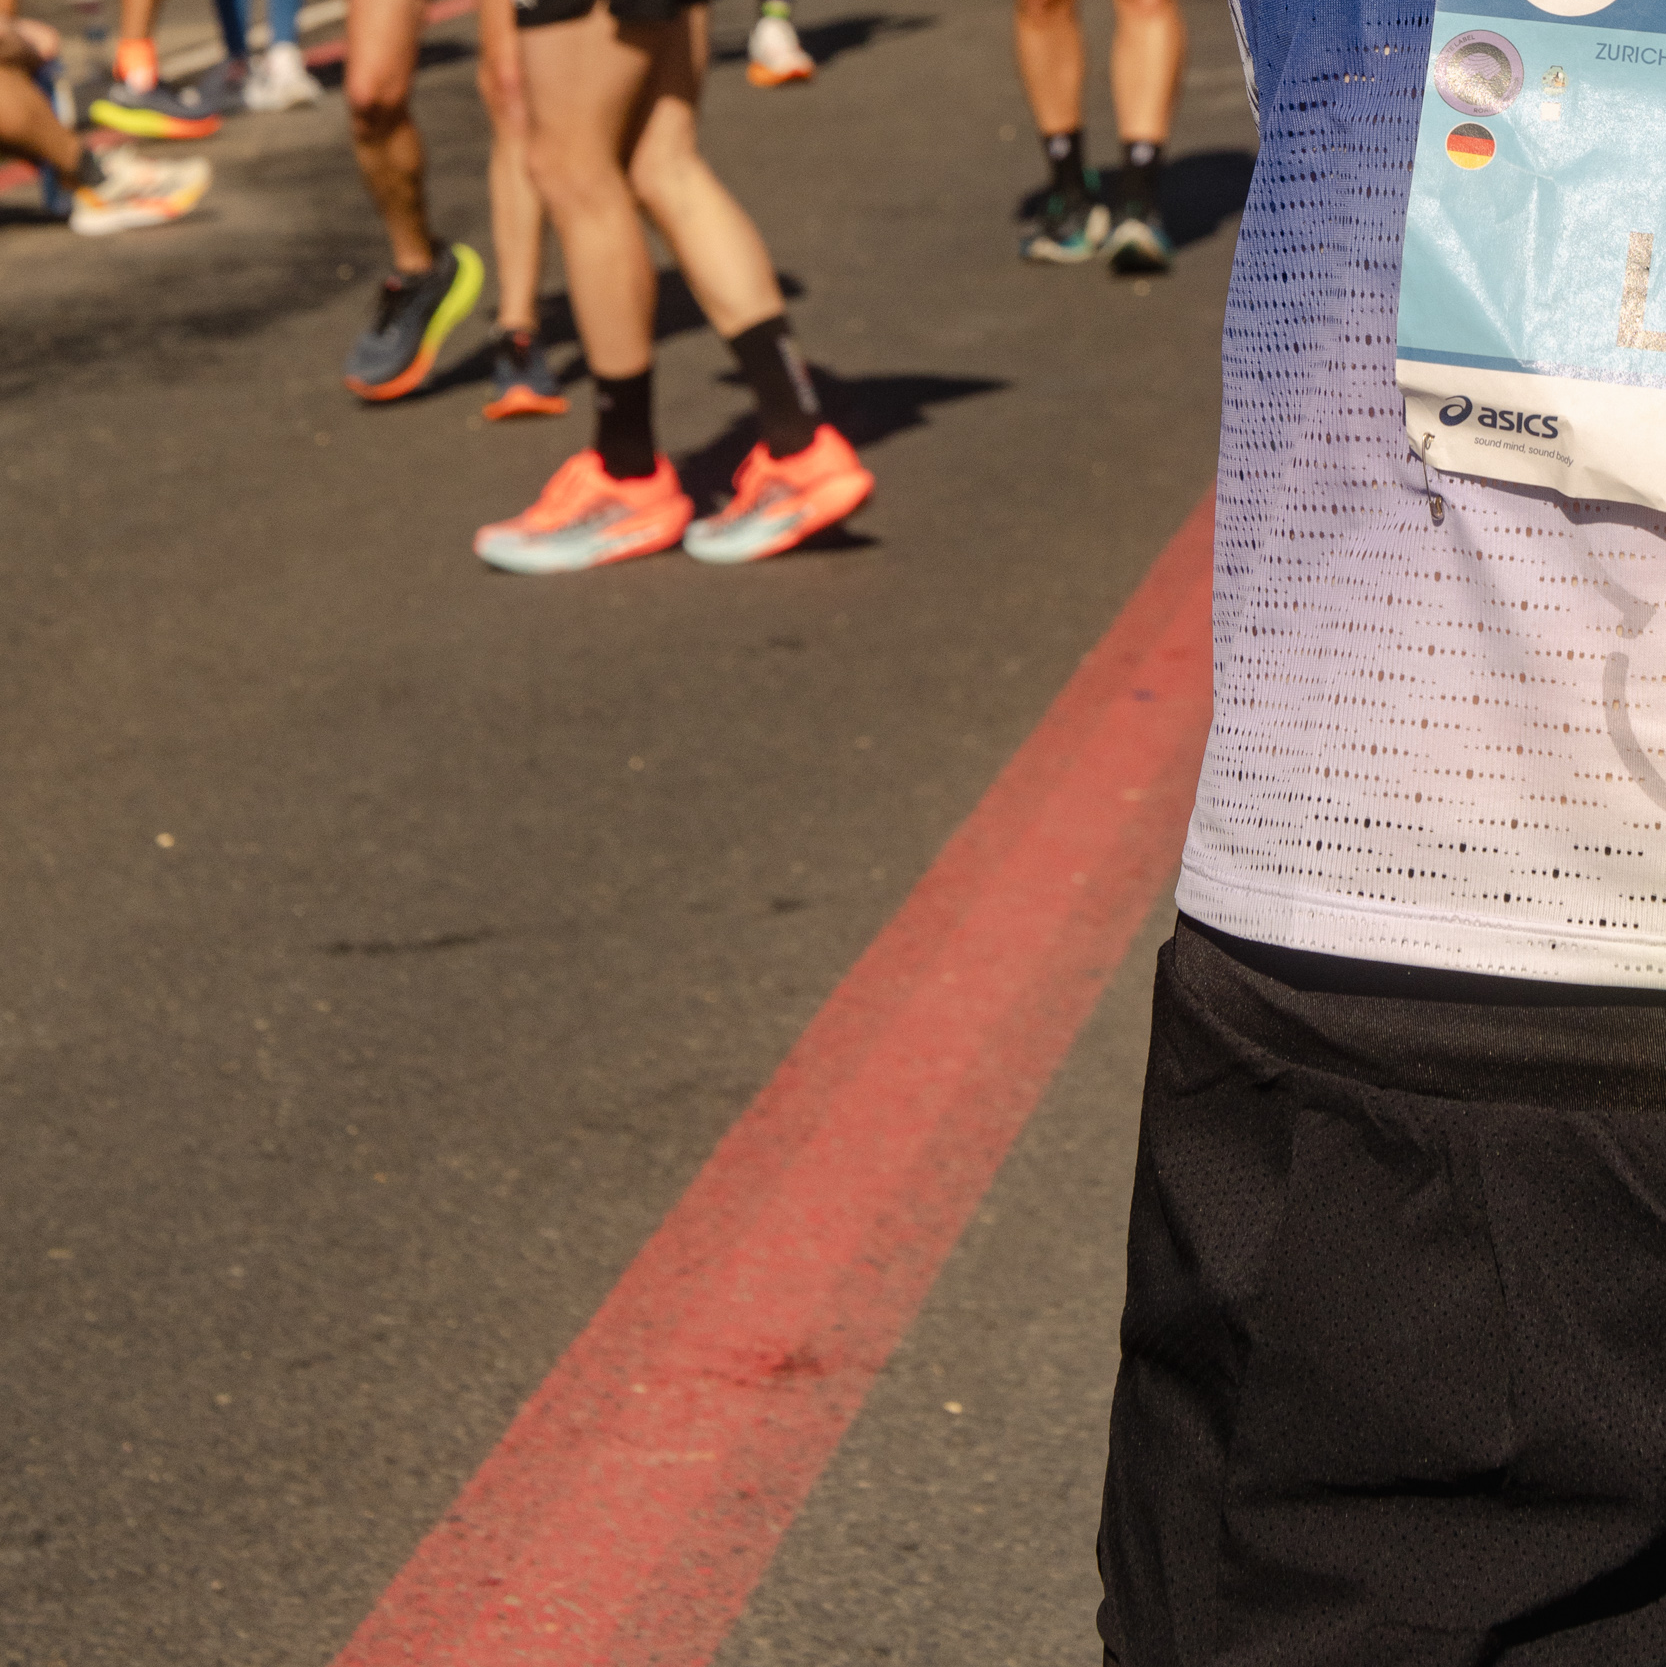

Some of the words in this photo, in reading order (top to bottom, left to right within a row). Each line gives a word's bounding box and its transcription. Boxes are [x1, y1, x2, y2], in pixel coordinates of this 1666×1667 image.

[1453, 34, 1476, 48] LABEL
[1473, 107, 1494, 115] ROA
[1477, 406, 1559, 440] asics
[1473, 435, 1502, 449] sound
[1502, 441, 1527, 454] mind,
[1528, 446, 1555, 460] sound
[1556, 451, 1575, 467] body
